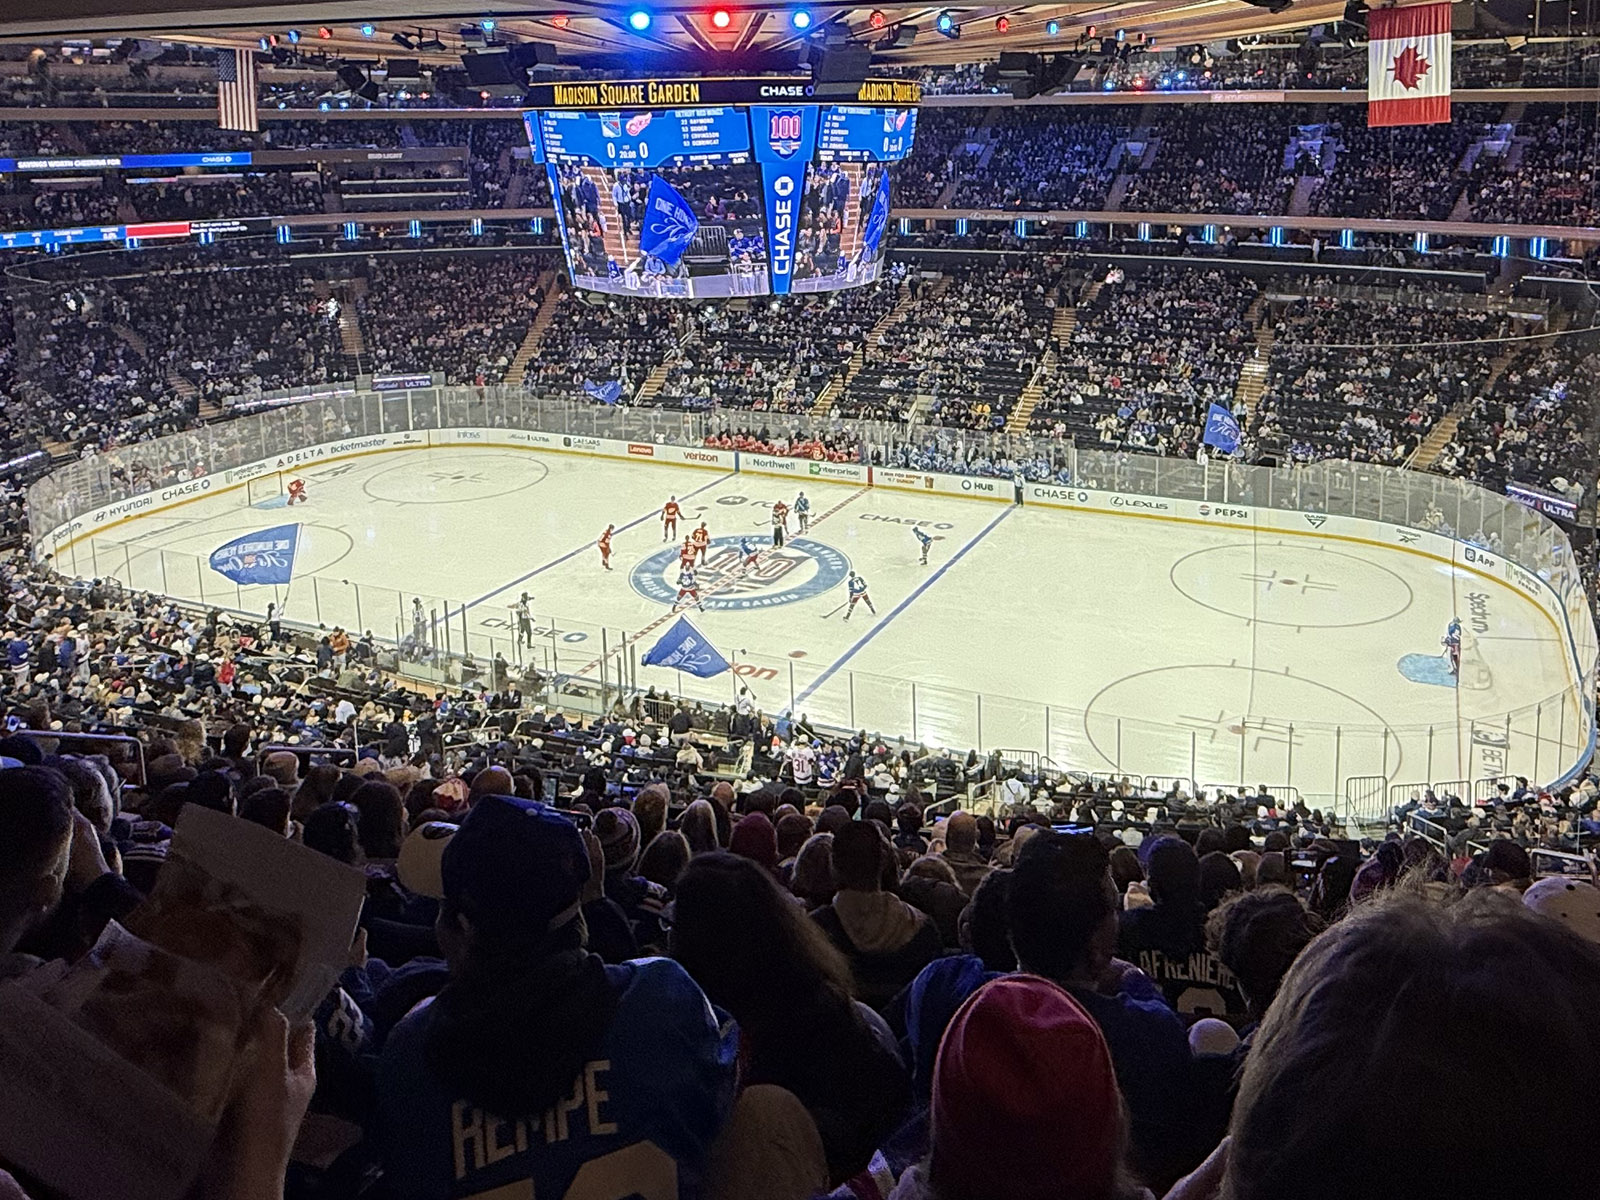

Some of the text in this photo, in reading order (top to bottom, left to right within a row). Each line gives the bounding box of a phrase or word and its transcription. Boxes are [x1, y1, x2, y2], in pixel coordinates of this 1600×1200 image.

[553, 81, 700, 105] MADISON SQUARE GARDEN
[760, 85, 804, 97] CHASE
[771, 115, 801, 139] 100
[607, 142, 616, 159] 0
[639, 142, 649, 159] 0
[108, 158, 121, 166] FOR
[774, 199, 793, 275] CHASE
[287, 448, 324, 464] DELTA
[683, 451, 719, 463] verizon
[753, 458, 796, 471] Northwell
[161, 483, 200, 501] CHASE
[974, 482, 994, 492] HUB
[1034, 487, 1076, 501] CHASE
[109, 497, 153, 516] HYUNDAI
[1126, 499, 1169, 510] LEXUS
[1543, 502, 1575, 520] ULTRA
[858, 512, 934, 528] CHASE
[1215, 507, 1248, 519] PEPSI
[794, 758, 806, 773] 31
